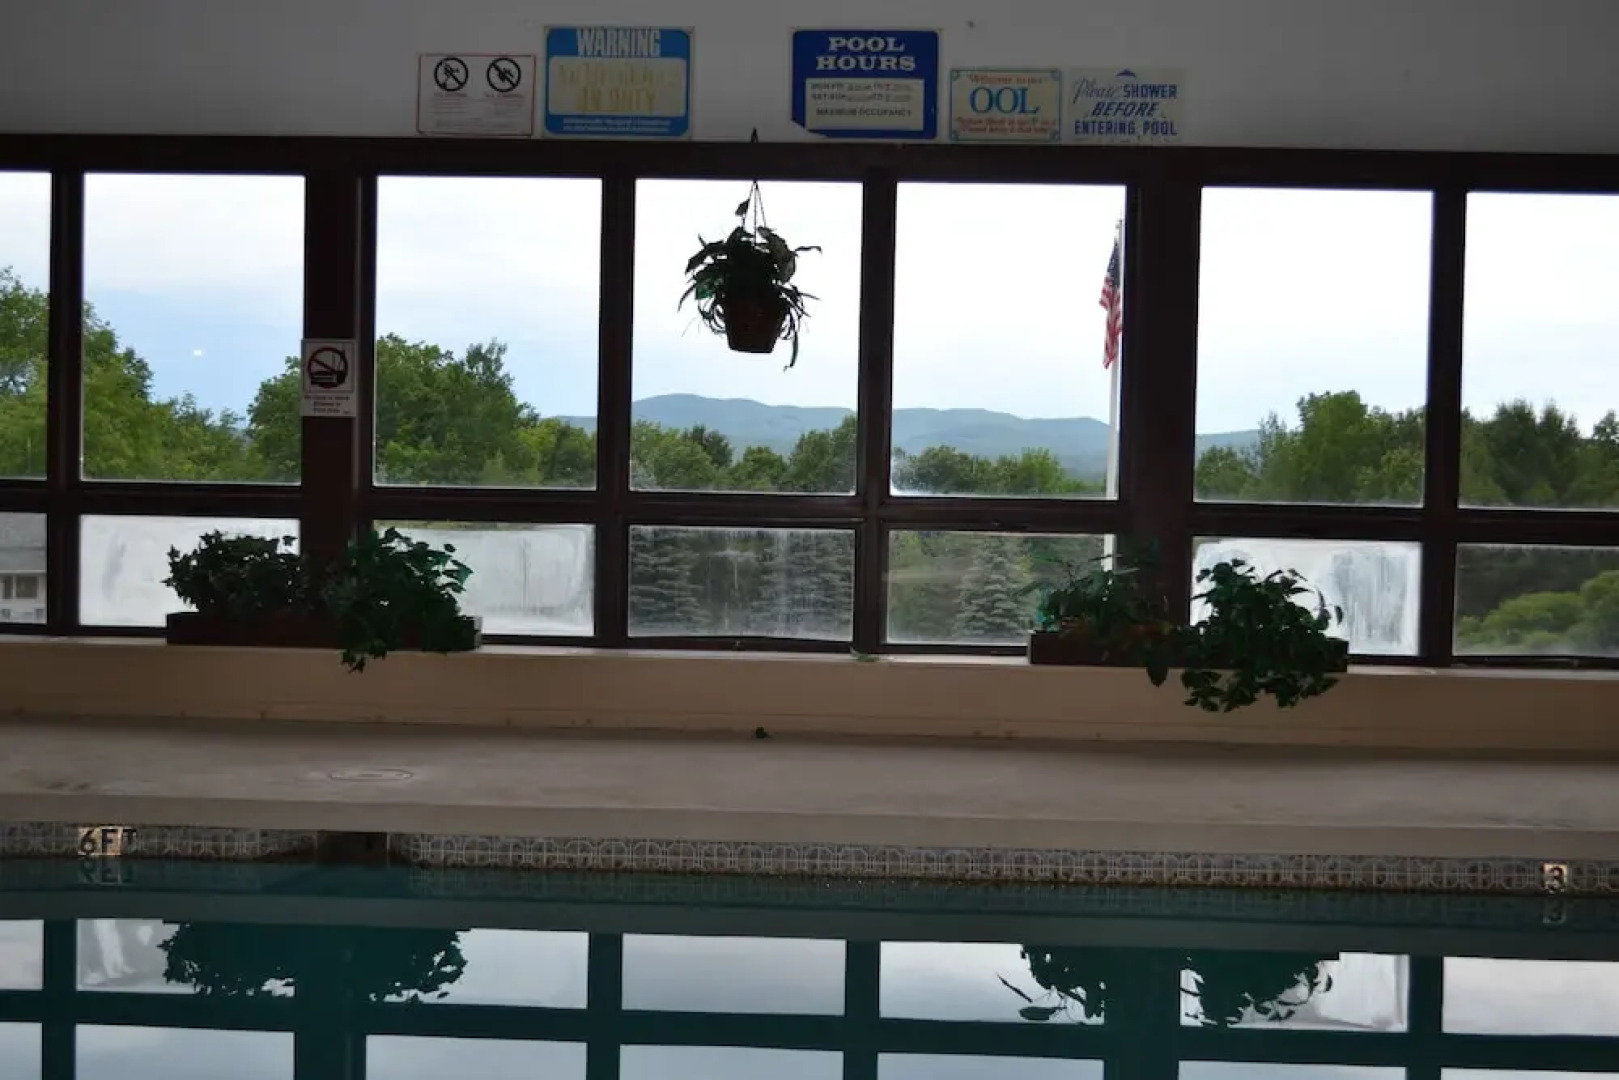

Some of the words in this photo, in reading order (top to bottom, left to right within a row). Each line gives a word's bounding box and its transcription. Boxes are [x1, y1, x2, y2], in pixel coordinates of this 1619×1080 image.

[577, 27, 661, 58] WARNING
[828, 36, 905, 52] POOL
[816, 56, 916, 71] HOURS
[1123, 83, 1178, 98] SHOWER
[969, 86, 1041, 114] OOL
[1092, 101, 1160, 117] BEFORE
[1074, 120, 1136, 136] ENTERING
[1142, 120, 1178, 137] POOL
[1546, 867, 1565, 893] 3
